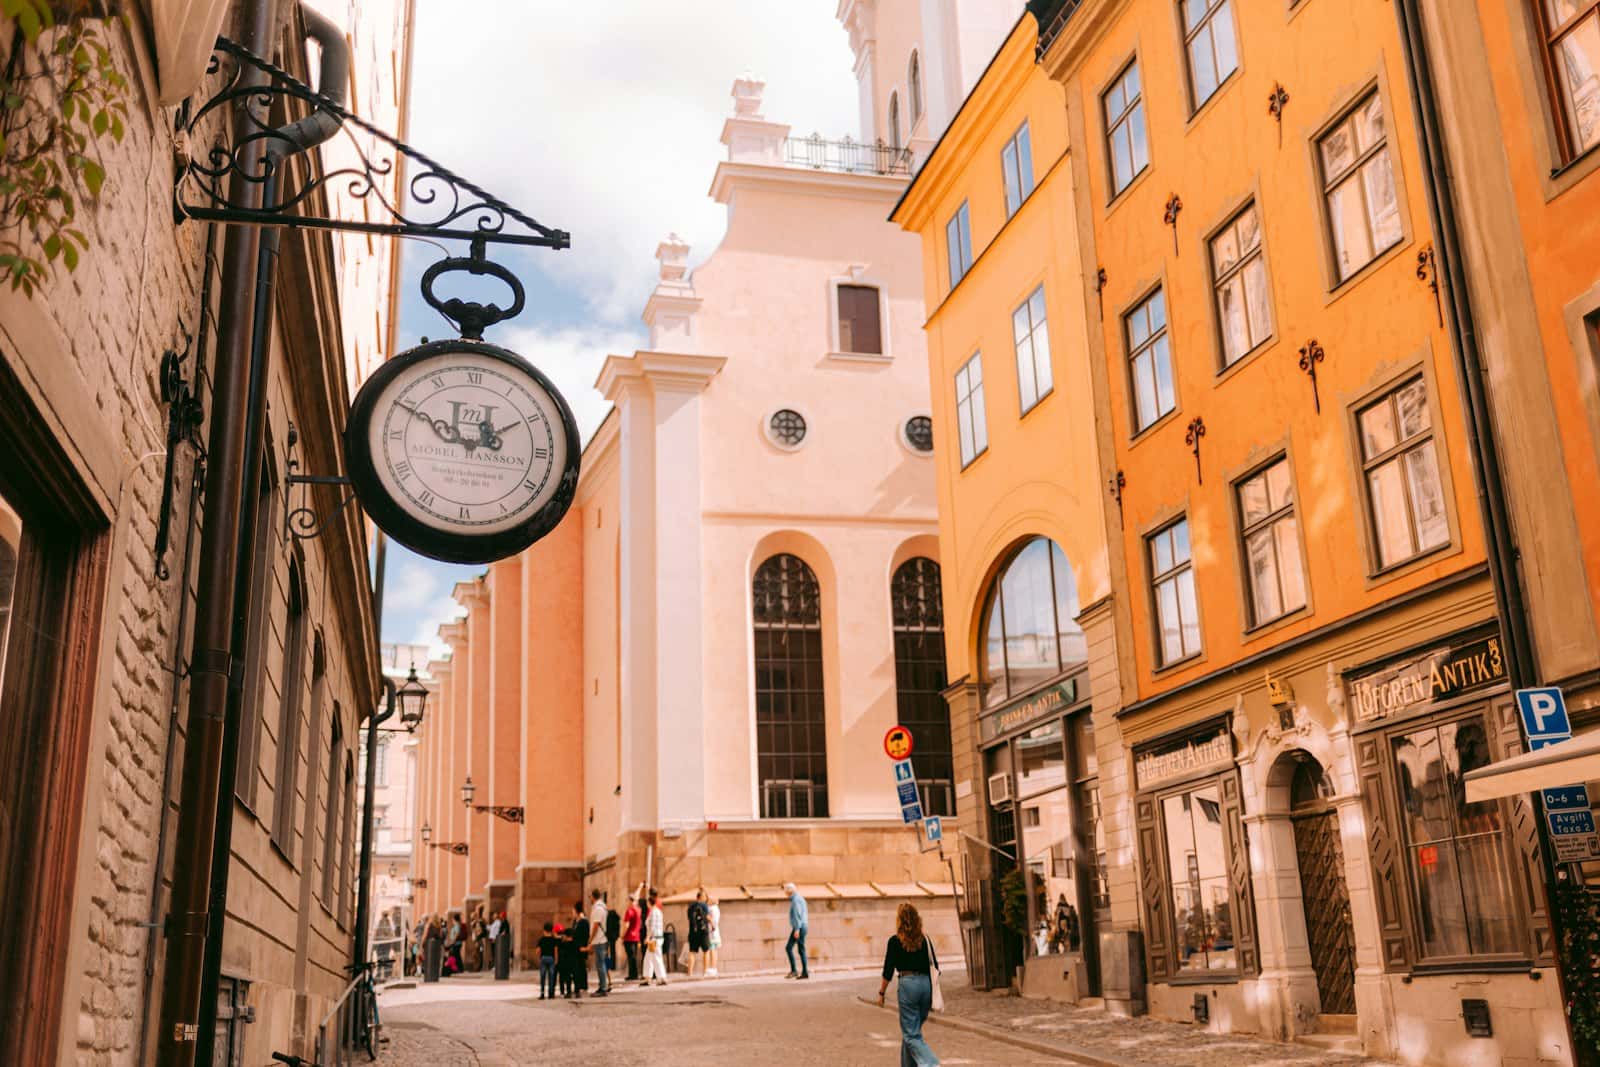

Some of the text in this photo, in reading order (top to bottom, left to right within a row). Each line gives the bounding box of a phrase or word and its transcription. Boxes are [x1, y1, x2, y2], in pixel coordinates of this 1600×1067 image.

[431, 375, 444, 389] XI
[467, 373, 482, 385] XII
[527, 414, 540, 423] II
[464, 449, 526, 466] HANSSON
[535, 448, 548, 459] III
[395, 461, 410, 481] VIII
[524, 479, 537, 491] IV
[418, 490, 434, 507] VII
[459, 507, 471, 519] VI
[1429, 653, 1491, 697] ANTIK
[1529, 693, 1557, 731] P
[1546, 793, 1568, 804] 0-6
[1556, 813, 1587, 825] Avgift
[1556, 823, 1591, 834] Taxa 2
